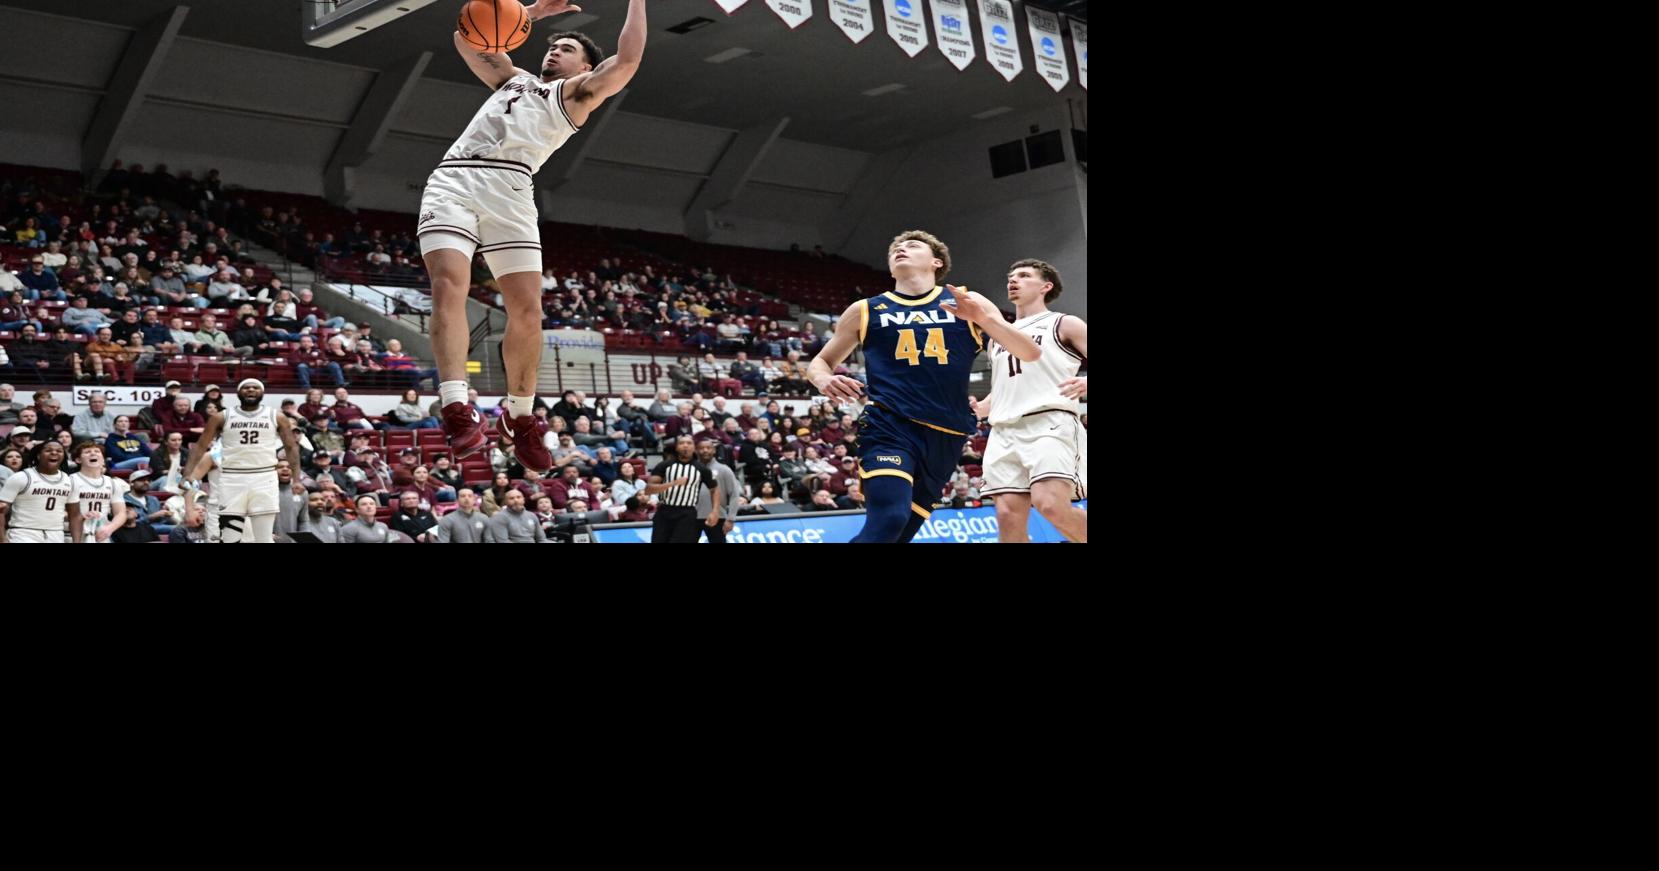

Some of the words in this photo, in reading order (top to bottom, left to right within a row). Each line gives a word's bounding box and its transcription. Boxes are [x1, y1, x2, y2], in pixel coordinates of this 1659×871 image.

[879, 310, 956, 327] NAU
[895, 327, 950, 366] 44
[130, 390, 162, 402] 103
[231, 421, 269, 429] MONTANA
[240, 430, 259, 444] 32
[45, 497, 56, 511] 0
[88, 501, 102, 512] 10
